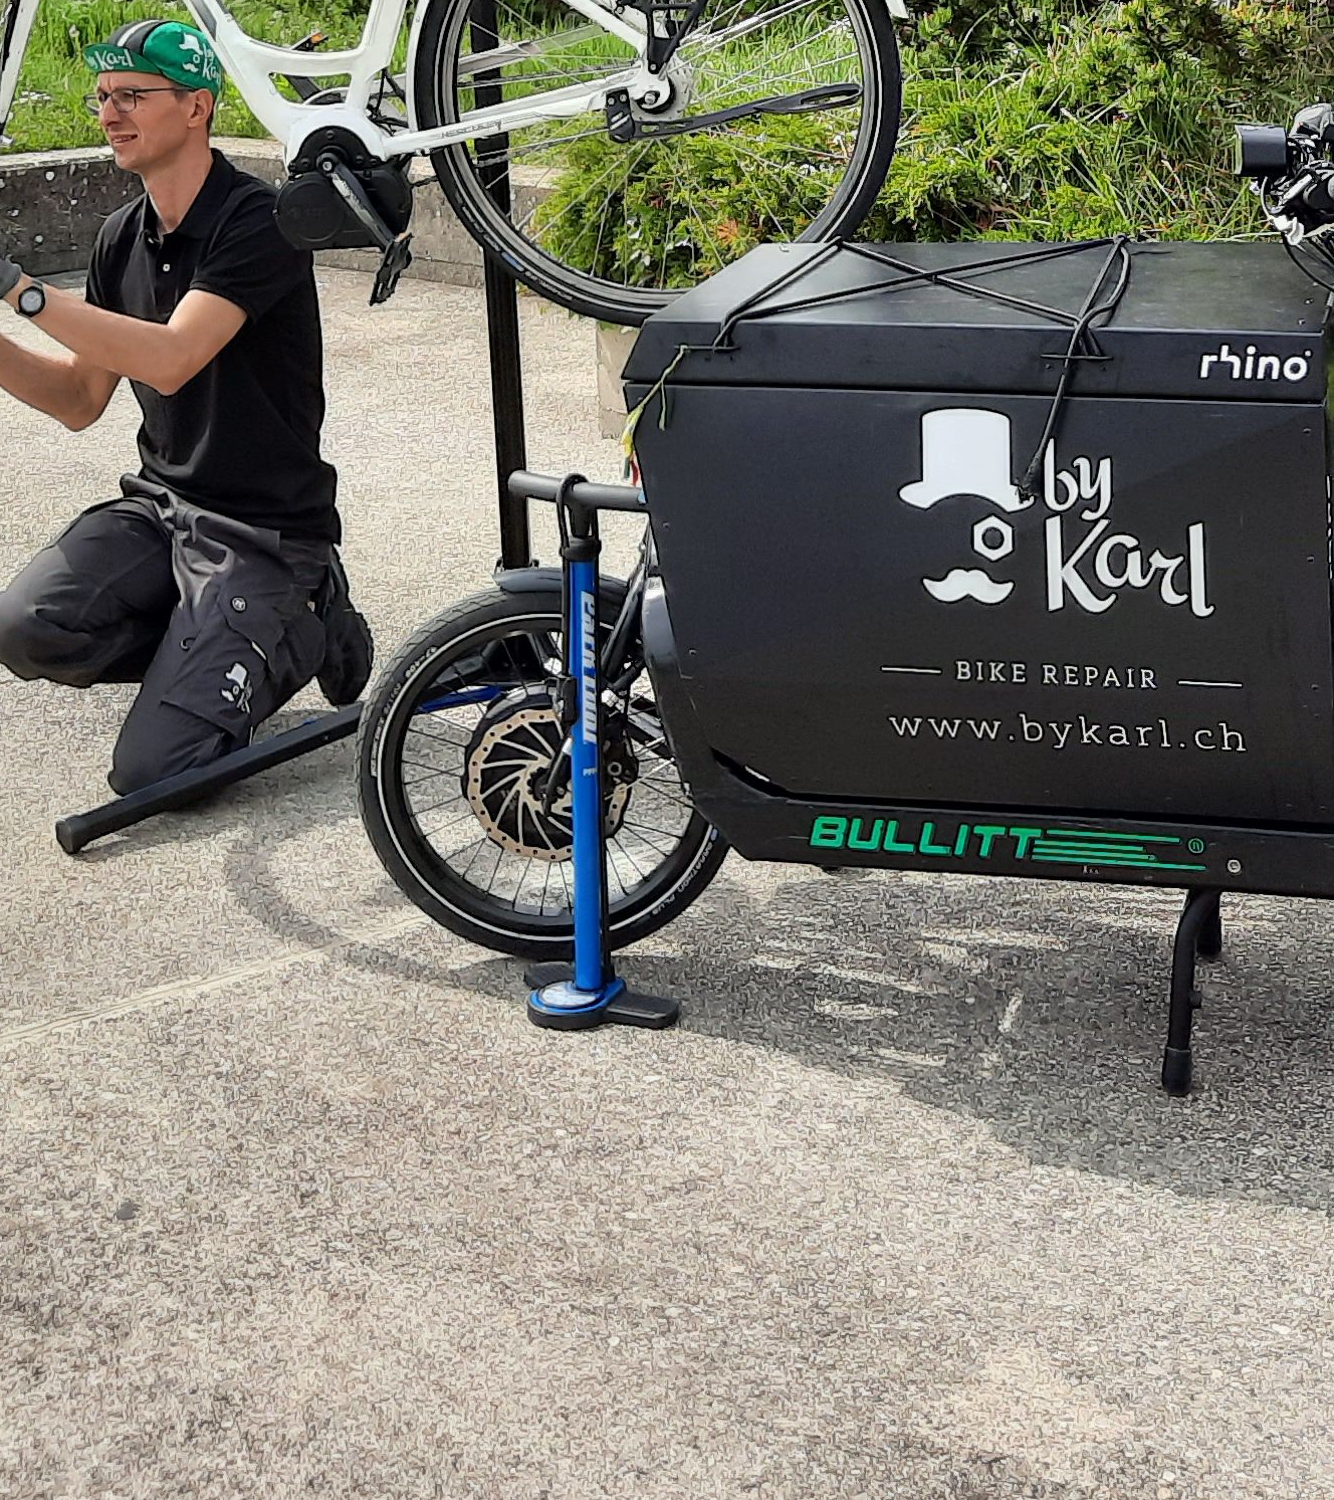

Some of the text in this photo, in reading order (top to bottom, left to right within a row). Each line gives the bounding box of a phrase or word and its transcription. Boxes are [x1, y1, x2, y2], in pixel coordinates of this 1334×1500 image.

[94, 49, 134, 70] Karl
[1200, 345, 1309, 381] rhino
[1044, 438, 1112, 520] by
[1045, 515, 1216, 617] Karl
[956, 661, 1158, 689] BIKE REPAIR
[888, 714, 1247, 752] www.bykarl.ch
[810, 816, 1043, 860] BULLITT
